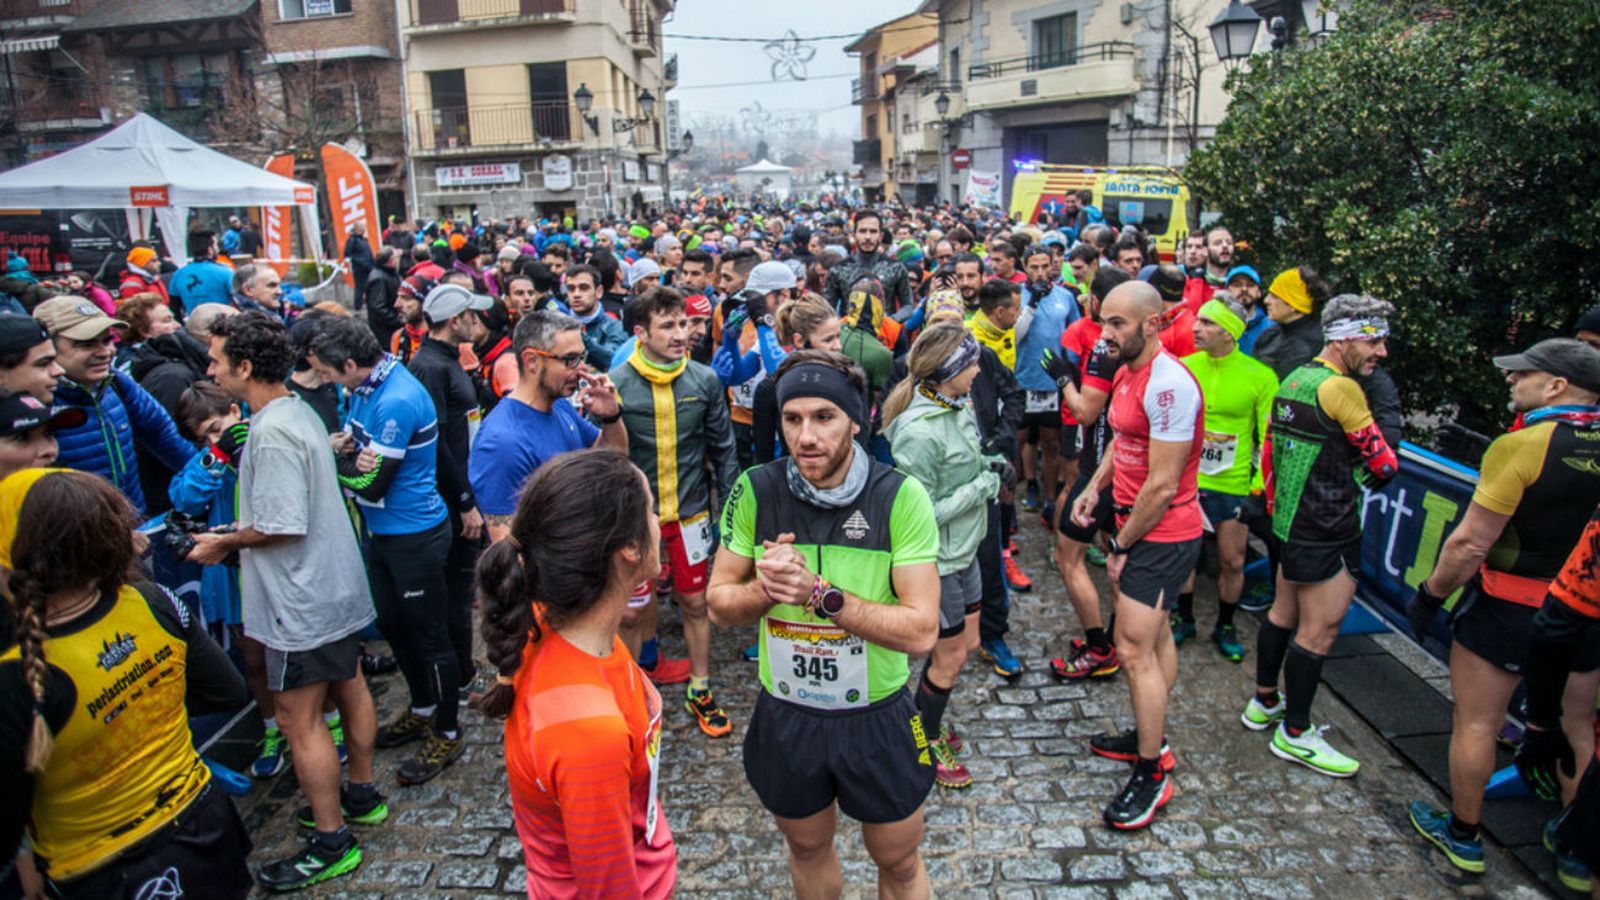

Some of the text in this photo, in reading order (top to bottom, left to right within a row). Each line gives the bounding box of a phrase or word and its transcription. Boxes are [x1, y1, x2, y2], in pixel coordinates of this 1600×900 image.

[134, 191, 165, 201] STIHL
[792, 653, 838, 682] 345
[910, 714, 928, 749] BERG
